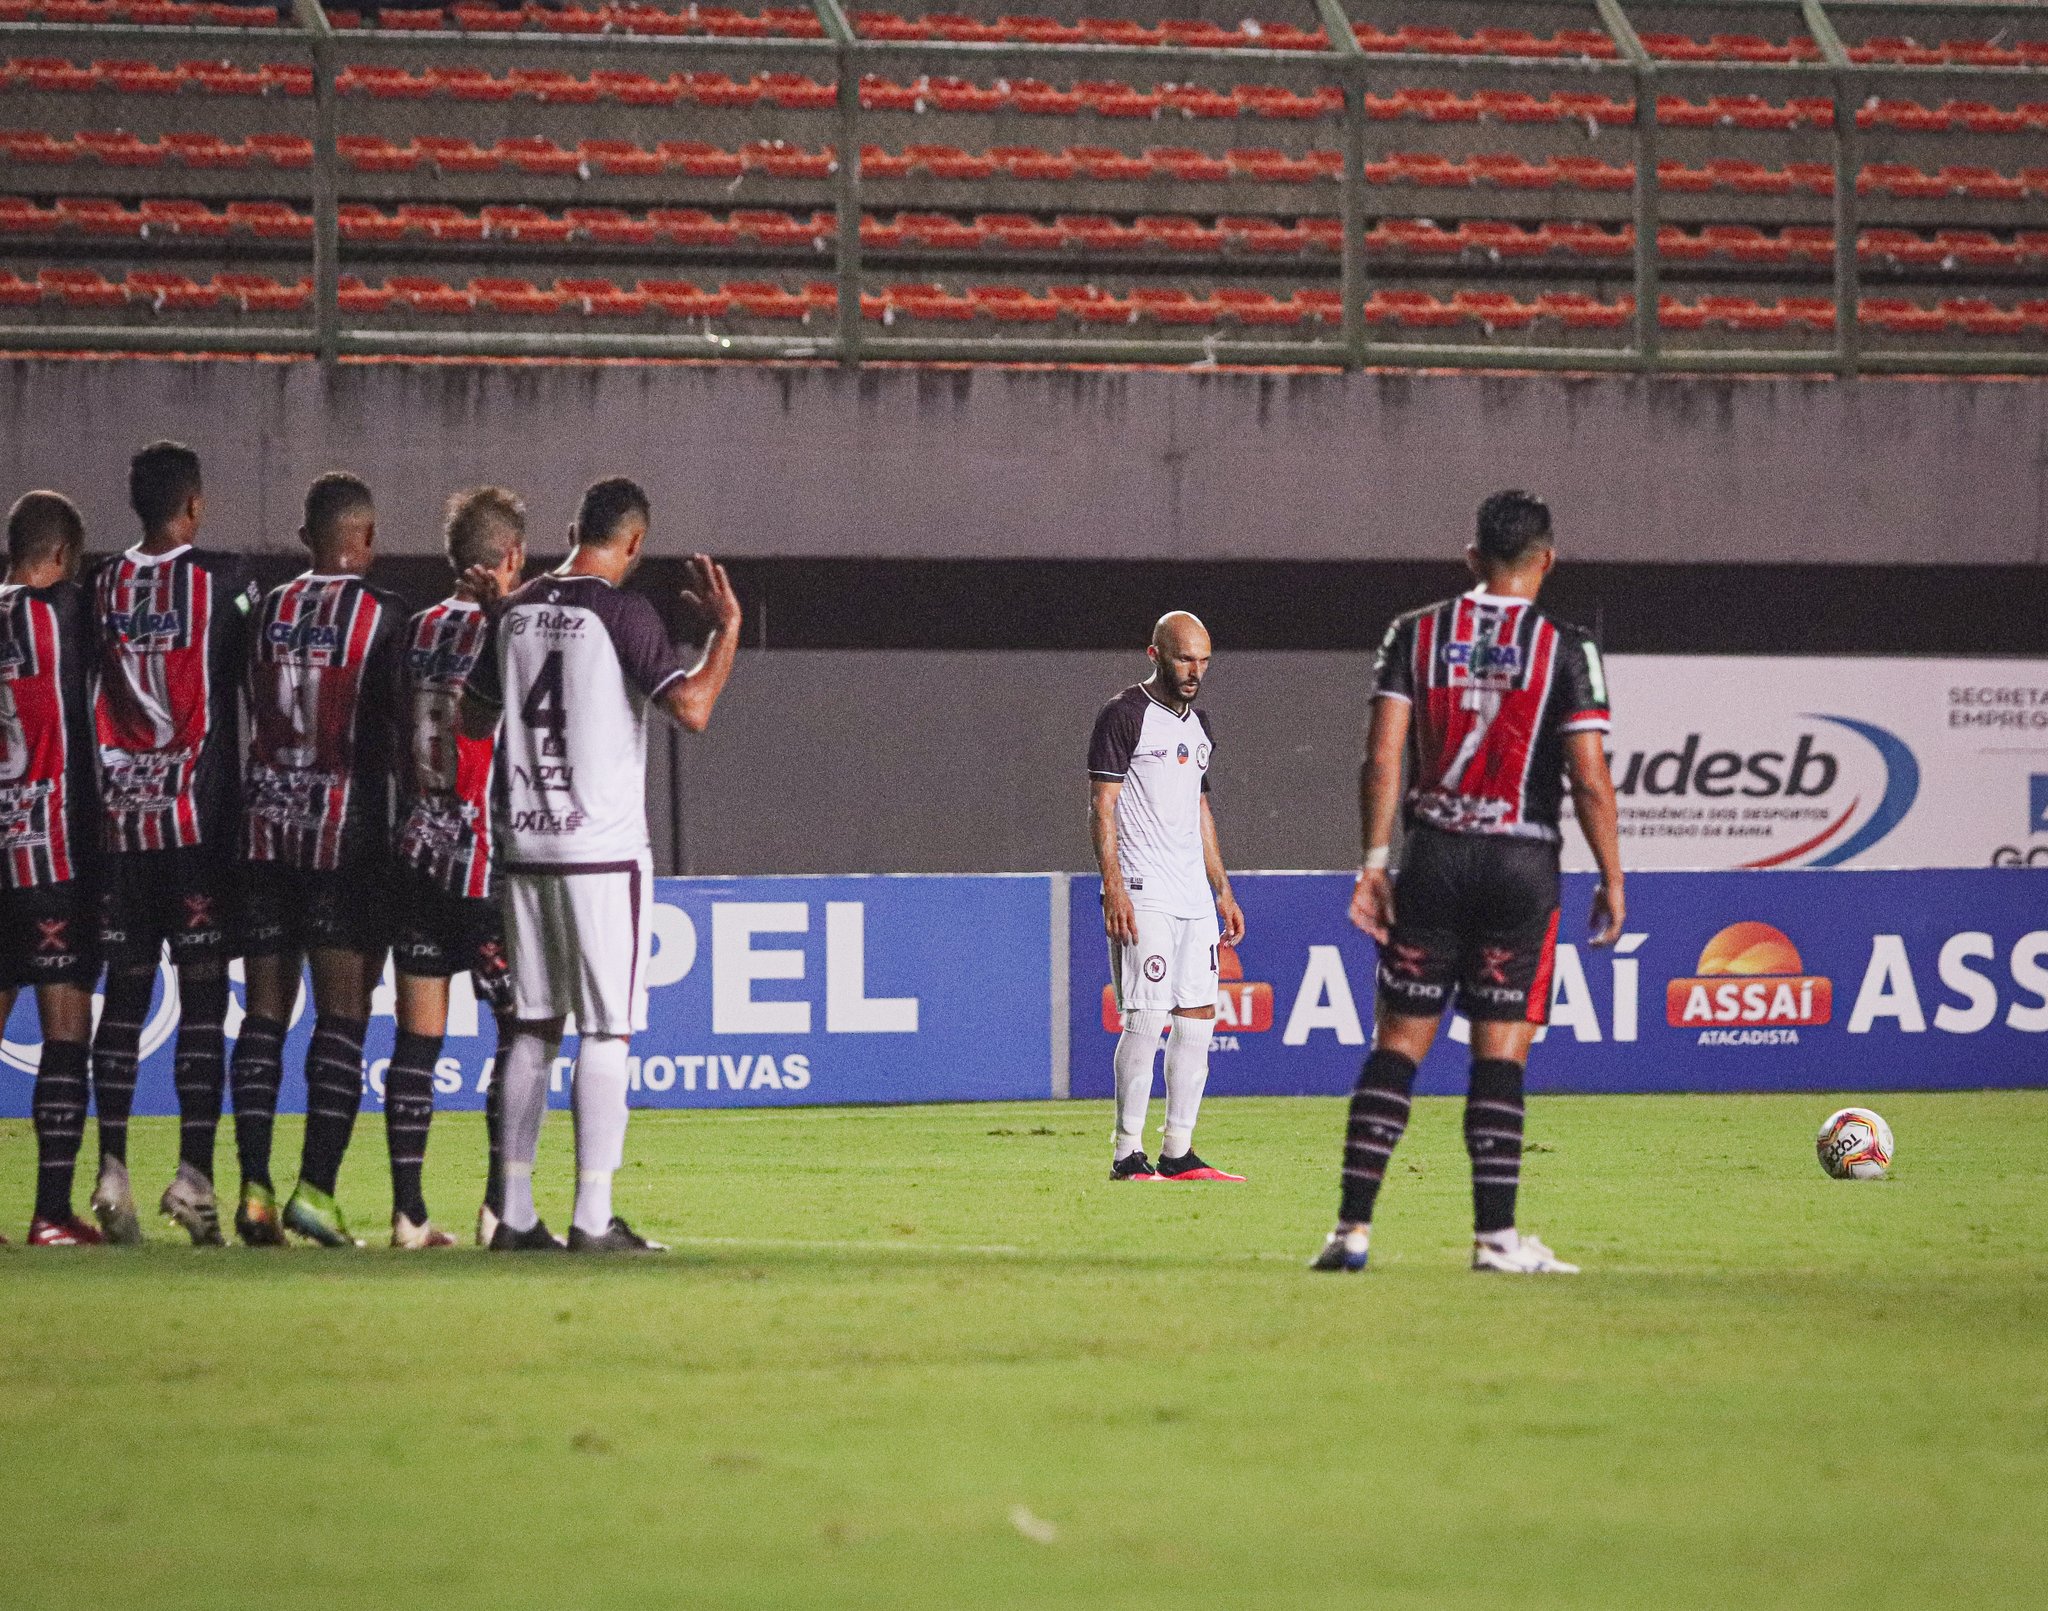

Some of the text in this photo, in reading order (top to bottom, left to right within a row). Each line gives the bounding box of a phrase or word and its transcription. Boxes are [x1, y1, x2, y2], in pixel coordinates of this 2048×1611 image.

[522, 650, 568, 757] 4
[1440, 685, 1501, 792] 7
[1282, 932, 1650, 1046] AAÍ
[1682, 980, 1814, 1022] ASSAÍ
[1846, 931, 2048, 1034] ASS
[1697, 1029, 1800, 1046] ATACADISTA
